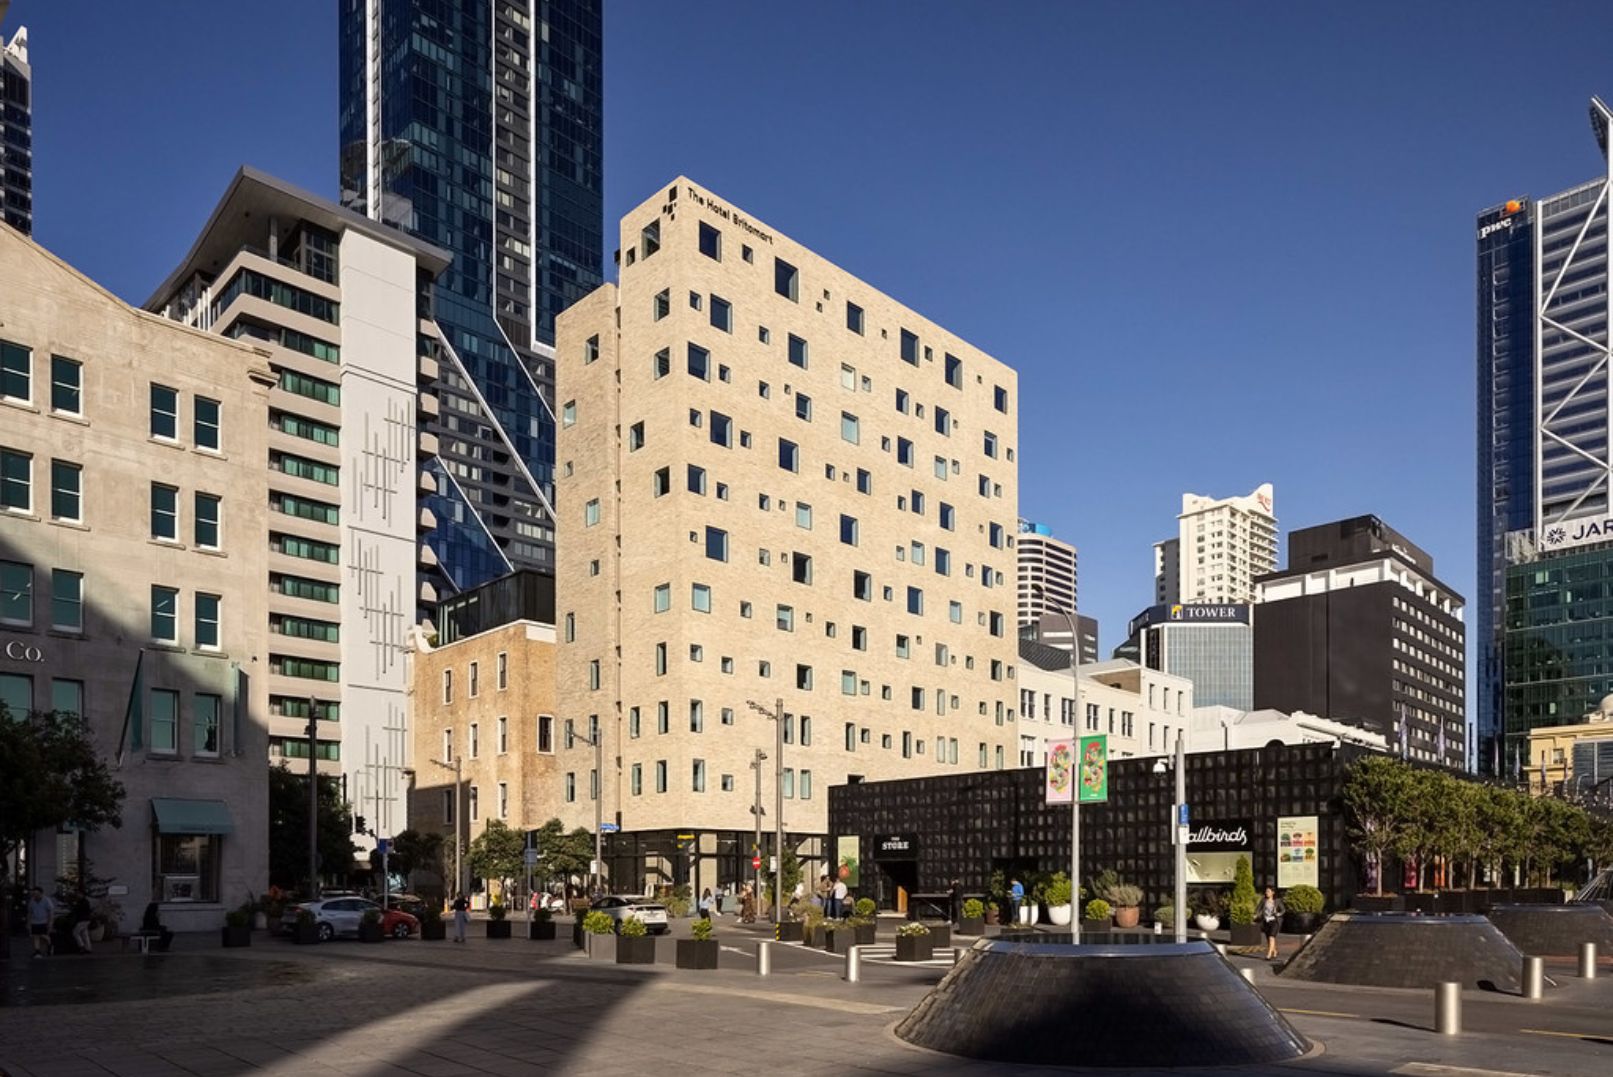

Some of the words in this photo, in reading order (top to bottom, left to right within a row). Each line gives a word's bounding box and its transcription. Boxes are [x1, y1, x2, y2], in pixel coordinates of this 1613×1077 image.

[688, 187, 704, 206] The
[706, 198, 730, 220] Hotel
[733, 212, 773, 245] Britomart
[1481, 218, 1512, 239] pwc
[1186, 607, 1236, 618] TOWER
[6, 641, 45, 662] Co.
[881, 841, 909, 850] STORE
[1187, 826, 1248, 845] allbirds
